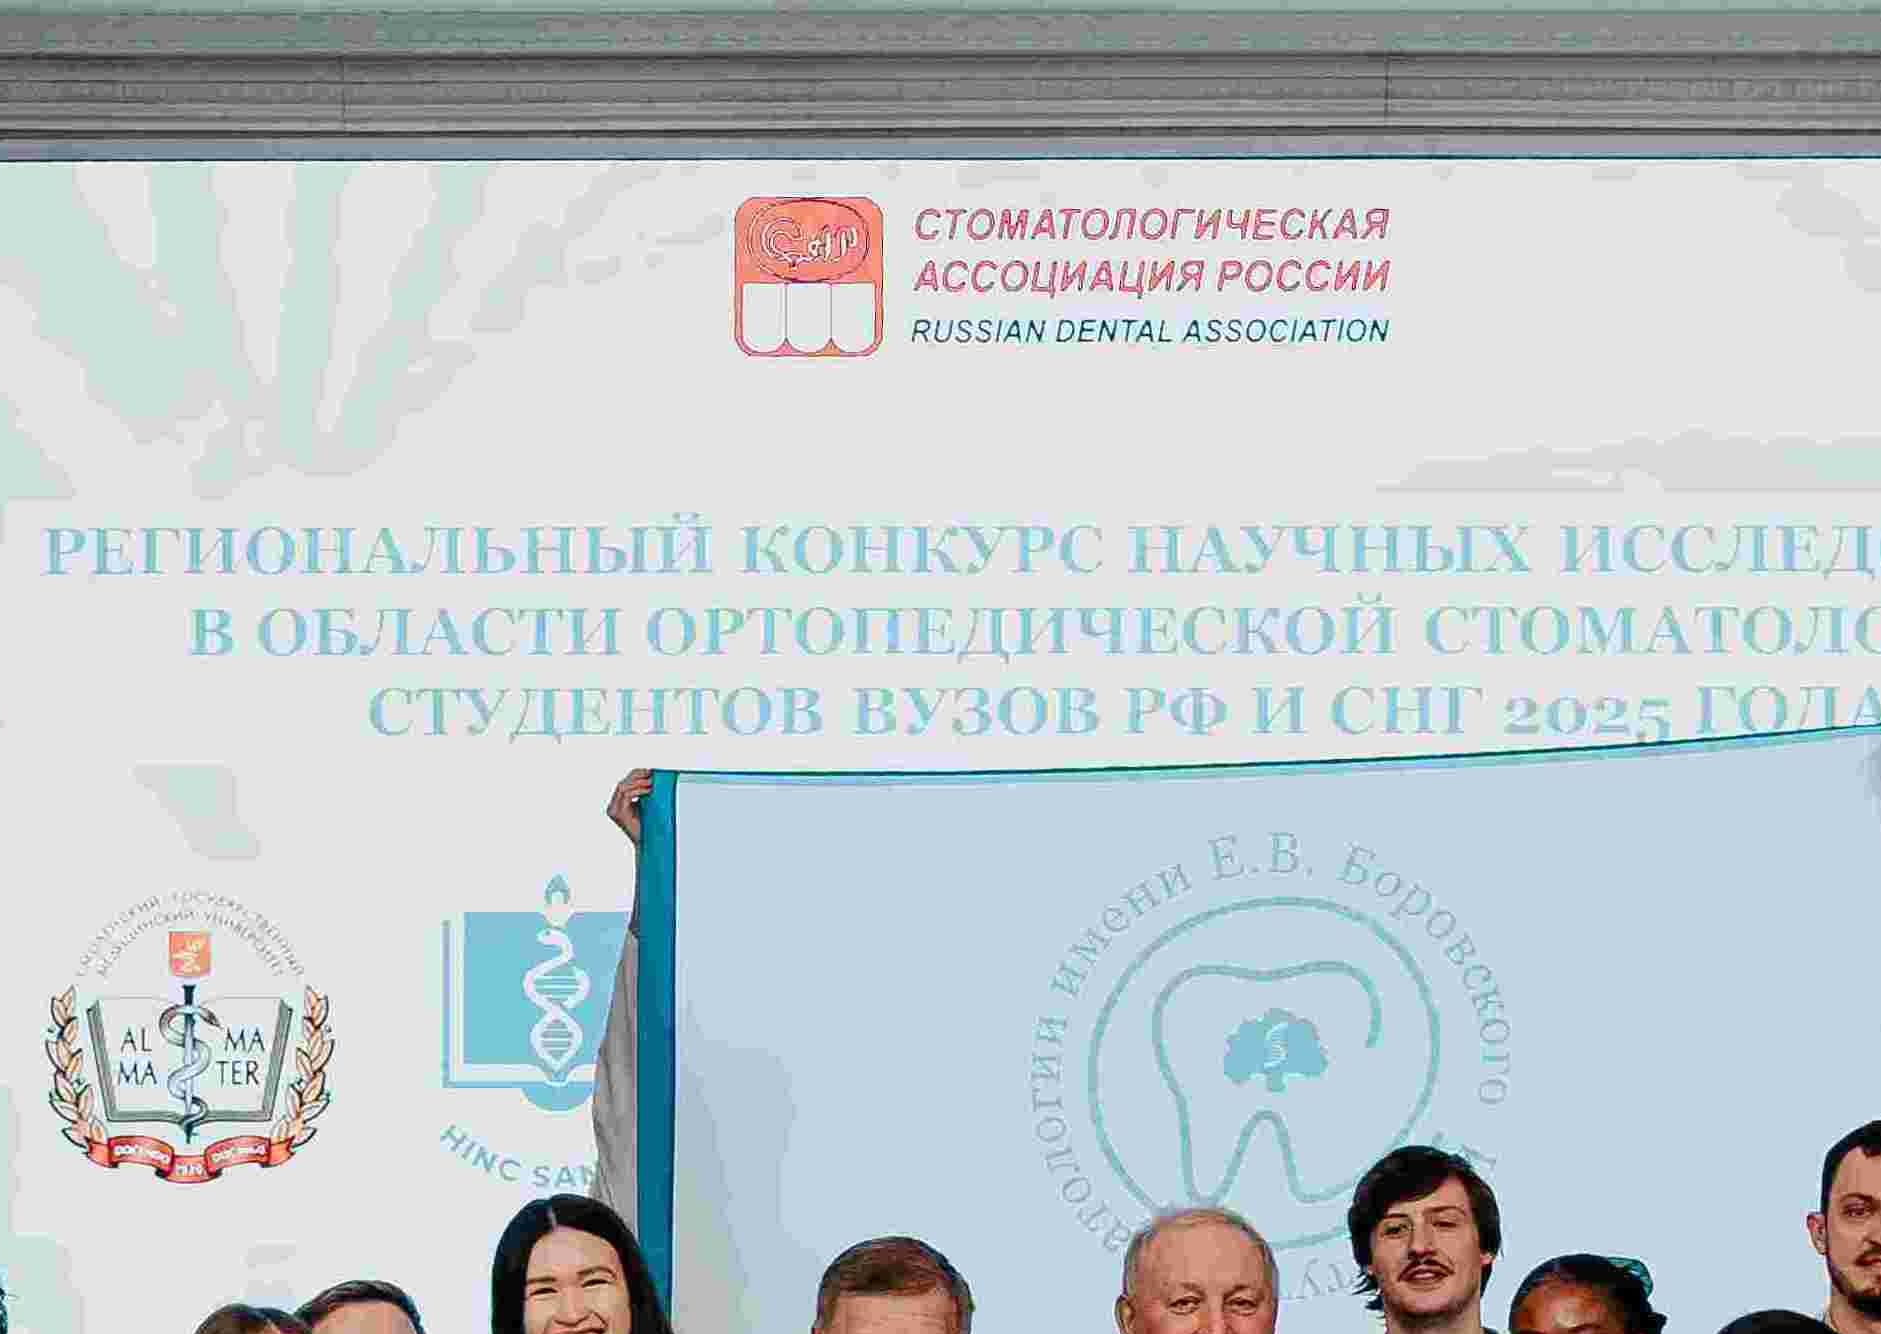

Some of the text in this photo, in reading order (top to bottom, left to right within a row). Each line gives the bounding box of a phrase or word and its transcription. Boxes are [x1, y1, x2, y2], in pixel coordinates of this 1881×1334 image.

[913, 207, 1390, 241] СТОМАТОЛОГИЧЕСКАЯ
[913, 260, 1390, 298] АССОЦИАЦИЯ РОССИИ
[911, 318, 1390, 344] RUSSIAN DENTAL ASSOCIATION
[40, 511, 713, 576] РЕГИОНАЛЬНЫЙ
[740, 523, 1104, 575] КОНКУРС
[1127, 523, 1534, 575] НАУЧНЫХ
[188, 607, 235, 656] В
[257, 606, 623, 657] ОБЛАСТИ
[647, 592, 1399, 664] ОРТОПЕДИЧЕСКОЙ
[368, 687, 823, 743] СТУДЕНТОВ
[851, 687, 1100, 737] ВУЗОВ
[1122, 687, 1229, 736] РФ
[1252, 686, 1307, 736] И
[1330, 685, 1484, 736] СНГ
[1504, 697, 1671, 742] 2025
[1050, 862, 1193, 1000] имени
[1336, 841, 1512, 1106] Боровского
[120, 1026, 265, 1052] AL MA
[118, 1060, 259, 1086] MA TER
[440, 1123, 601, 1189] HINC SAN
[1030, 1014, 1132, 1252] атологии
